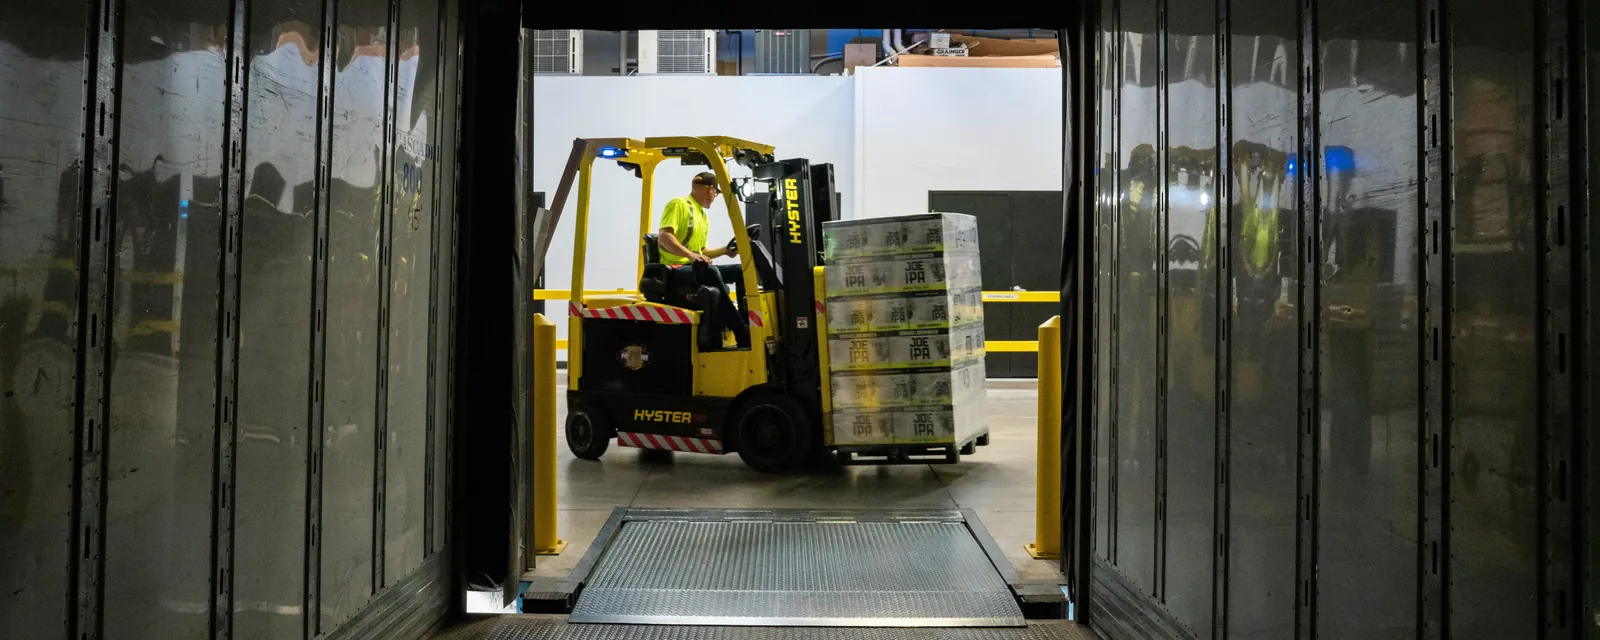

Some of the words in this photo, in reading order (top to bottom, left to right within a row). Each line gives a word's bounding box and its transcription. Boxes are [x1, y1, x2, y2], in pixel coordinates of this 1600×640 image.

[784, 178, 802, 244] HYSTER
[885, 238, 900, 246] IPA
[927, 235, 940, 244] IPA
[845, 265, 864, 274] JOE
[904, 261, 924, 271] JOE
[845, 275, 865, 287] IPA
[905, 271, 925, 283] IPA
[891, 314, 905, 322] IPA
[932, 312, 946, 320] IPA
[849, 340, 868, 349] JOE
[909, 337, 929, 347] JOE
[849, 350, 868, 362] IPA
[910, 347, 930, 360] IPA
[935, 388, 949, 396] IPA
[634, 409, 692, 423] HYSTER
[852, 415, 872, 424] JOE
[914, 413, 933, 423] JOE
[853, 424, 872, 436] IPA
[914, 423, 934, 436] IPA
